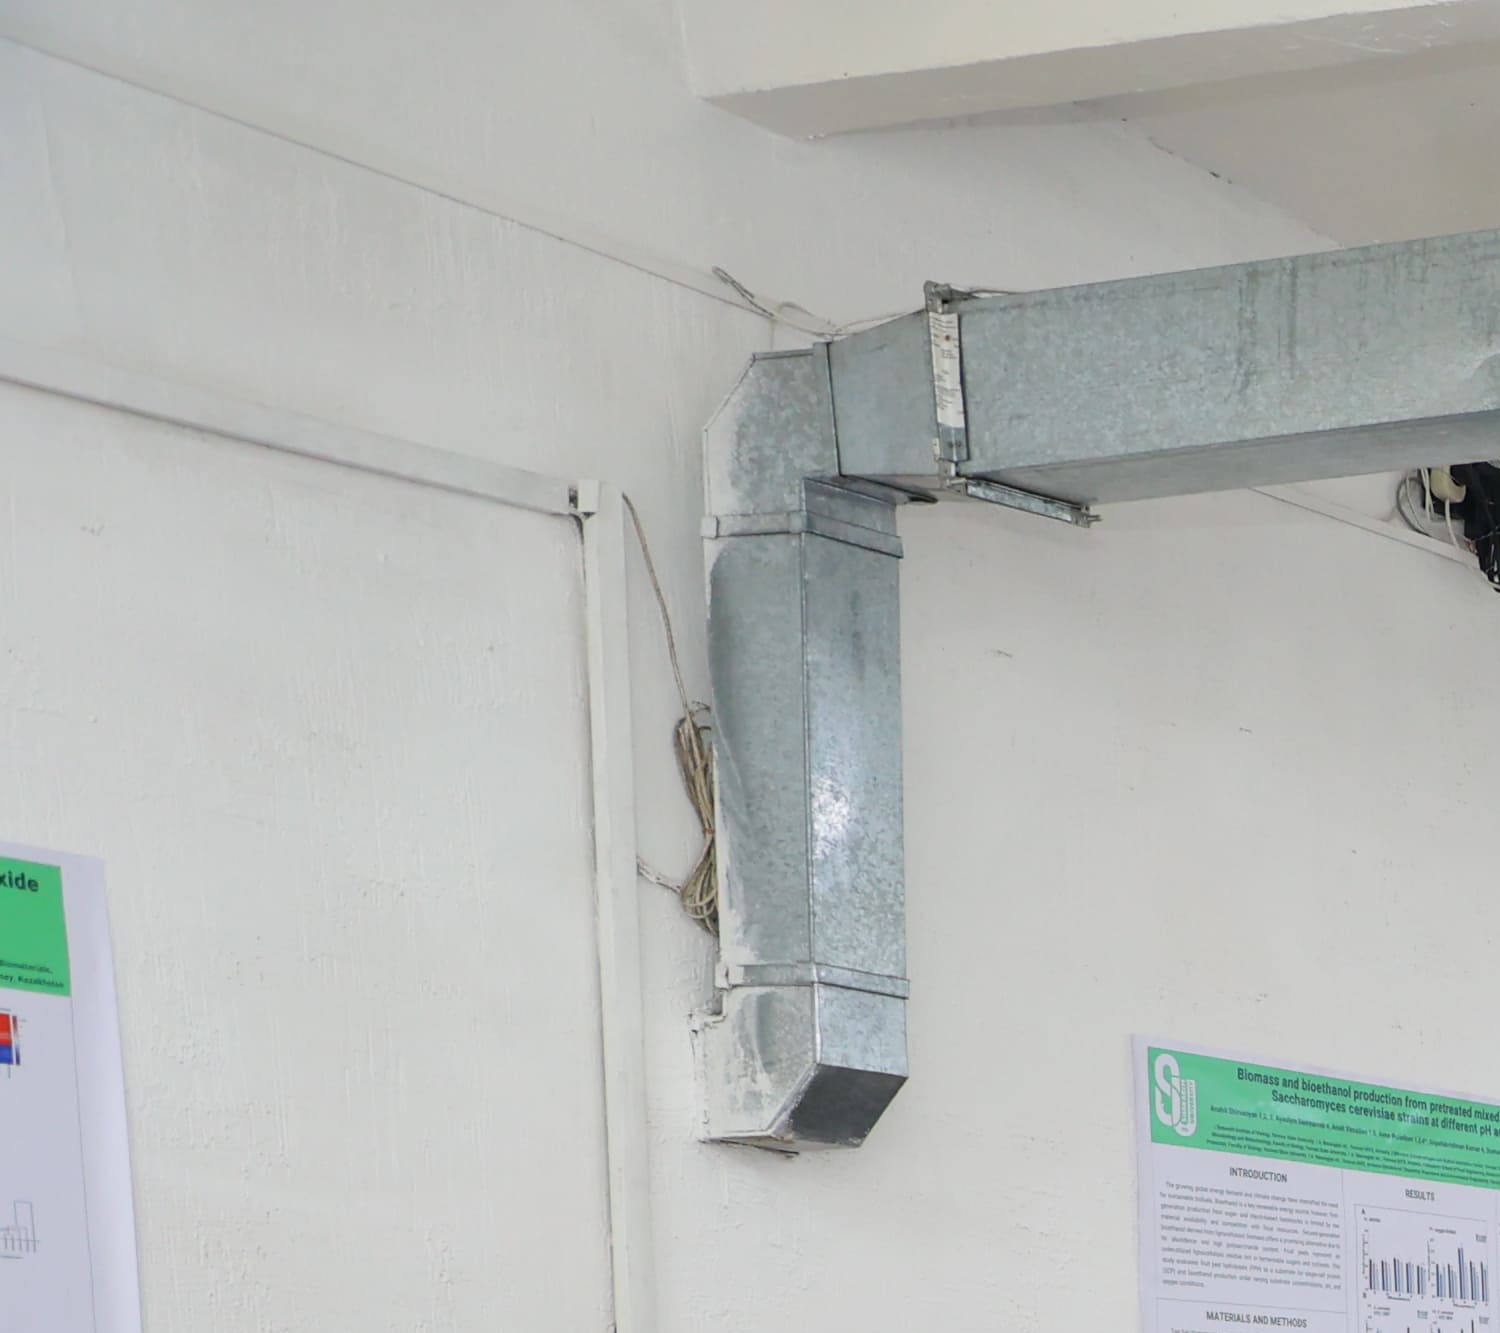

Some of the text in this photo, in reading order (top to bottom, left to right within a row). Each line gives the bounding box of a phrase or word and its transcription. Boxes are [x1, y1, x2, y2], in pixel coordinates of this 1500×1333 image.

[1237, 1067, 1280, 1087] Biomass
[1281, 1077, 1300, 1090] and
[1301, 1079, 1352, 1098] bioethanol
[1353, 1089, 1403, 1107] production
[1404, 1095, 1427, 1111] from
[1429, 1102, 1473, 1119] pretreated
[1474, 1108, 1500, 1123] mixed
[1271, 1089, 1346, 1113] Saccharomyces
[1348, 1104, 1396, 1121] cerevisiae
[1397, 1111, 1430, 1127] strains
[1431, 1117, 1440, 1128] at
[1441, 1116, 1478, 1134] different
[1480, 1124, 1492, 1137] pH
[1229, 1166, 1288, 1183] INTRODUCTION
[1405, 1188, 1435, 1202] RESULTS
[1206, 1311, 1308, 1329] MATERIALS AND METHODS
